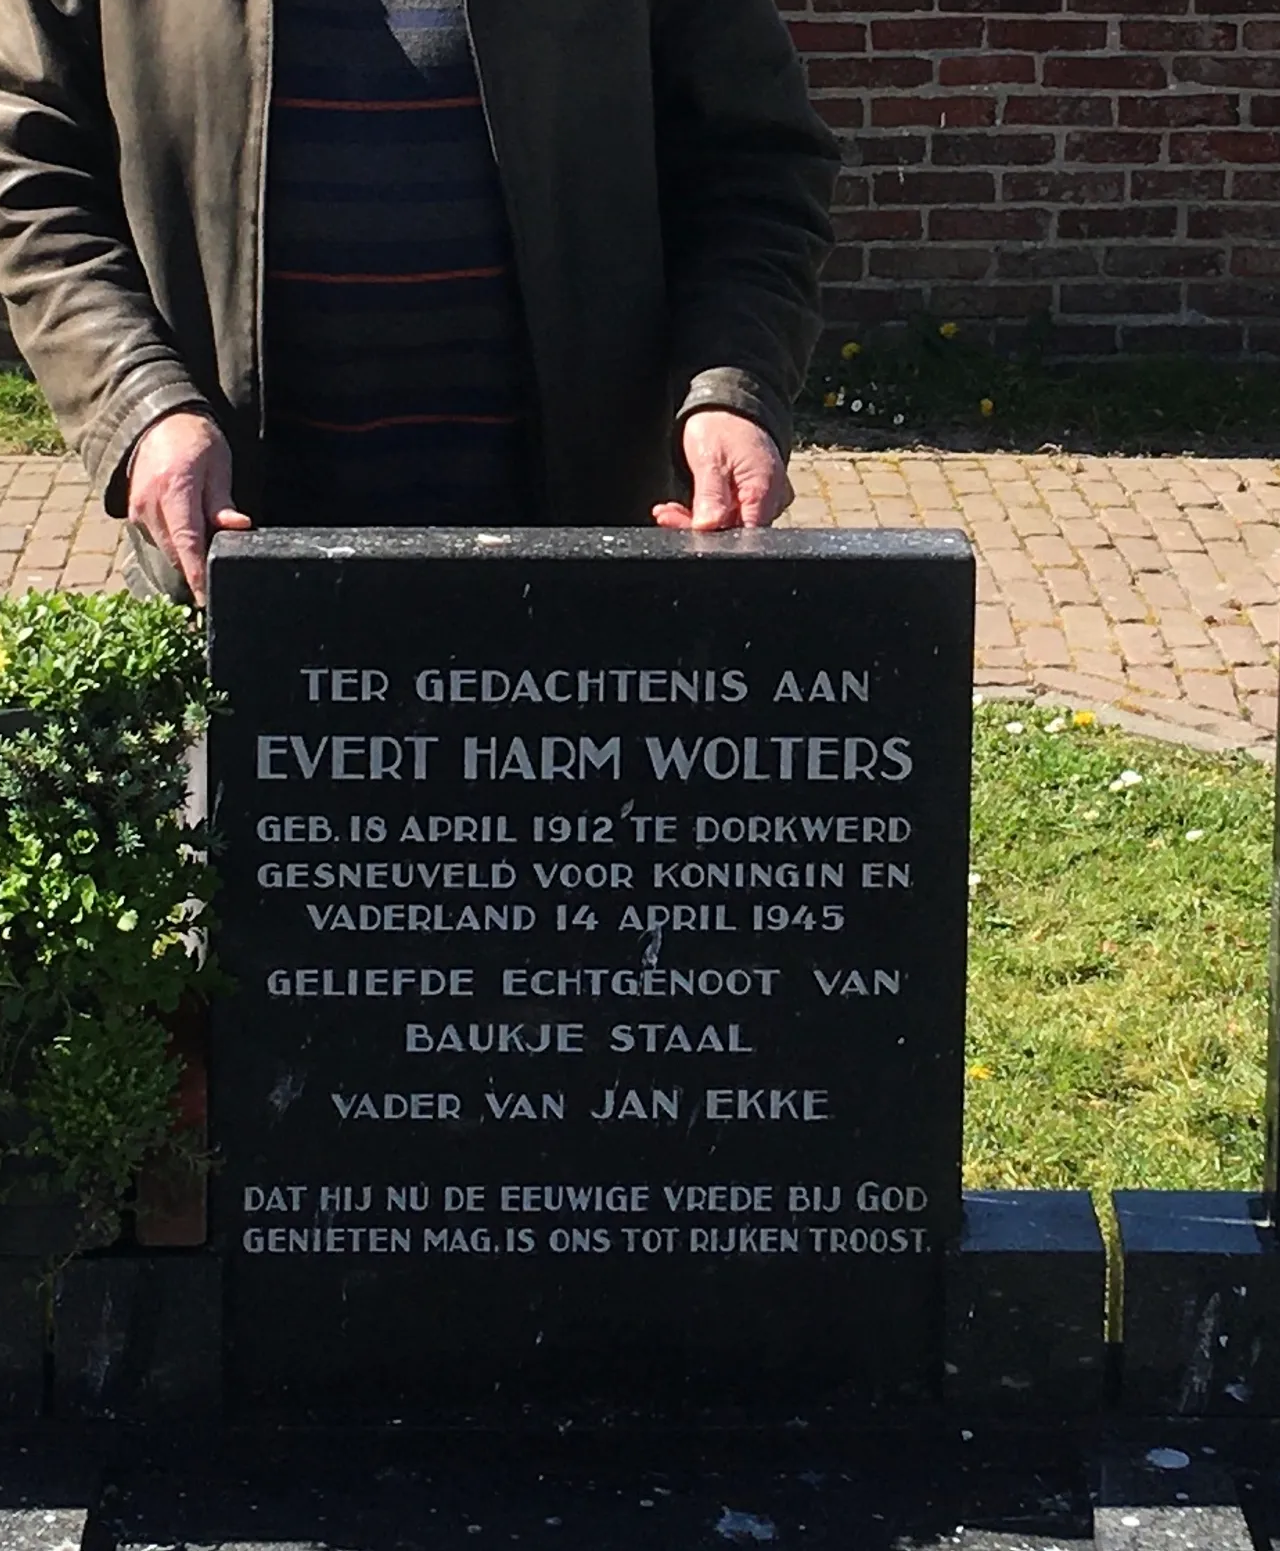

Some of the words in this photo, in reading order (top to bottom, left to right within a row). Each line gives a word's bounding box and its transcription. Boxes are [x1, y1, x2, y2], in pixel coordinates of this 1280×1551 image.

[299, 667, 389, 703] TER
[415, 668, 749, 704] GEDACHTENIS
[772, 669, 870, 703] AAN
[256, 734, 440, 781] EVERT
[463, 735, 622, 781] HARM
[644, 735, 914, 782] WOLTERS
[255, 815, 340, 843] GEB.
[349, 815, 388, 843] 18
[399, 815, 518, 843] APRIL
[533, 815, 615, 844] 1912
[629, 815, 678, 843] TE
[695, 815, 912, 844] DORKWERD
[256, 861, 517, 889] GESNEUVELD
[533, 862, 635, 889] VOOR
[653, 862, 845, 889] KONINGIN
[861, 862, 911, 889] EN
[306, 903, 536, 932] VADERLAND
[556, 903, 600, 932] 14
[617, 904, 737, 932] APRIL
[752, 904, 845, 932] 1945
[267, 968, 475, 997] GELIEFDE
[502, 968, 781, 998] ECHTGENOOT
[812, 968, 901, 997] VAN
[405, 1022, 585, 1054] BAUKJE
[609, 1023, 753, 1054] STAAL
[330, 1092, 461, 1120] VADER
[484, 1091, 566, 1120] VAN
[705, 1088, 829, 1121] EKKE
[243, 1185, 308, 1213] DAT
[319, 1185, 372, 1213] HIJ
[386, 1185, 430, 1213] NU
[443, 1185, 485, 1213] DE
[500, 1184, 650, 1213] EEUWIGE
[663, 1184, 774, 1213] VREDE
[787, 1184, 843, 1213] BIJ
[242, 1226, 411, 1254] GENIETEN
[506, 1227, 536, 1254] IS
[548, 1226, 612, 1254] ONS
[620, 1227, 681, 1253] TOT
[688, 1227, 800, 1253] RIJKEN
[809, 1227, 932, 1253] TROOST.
